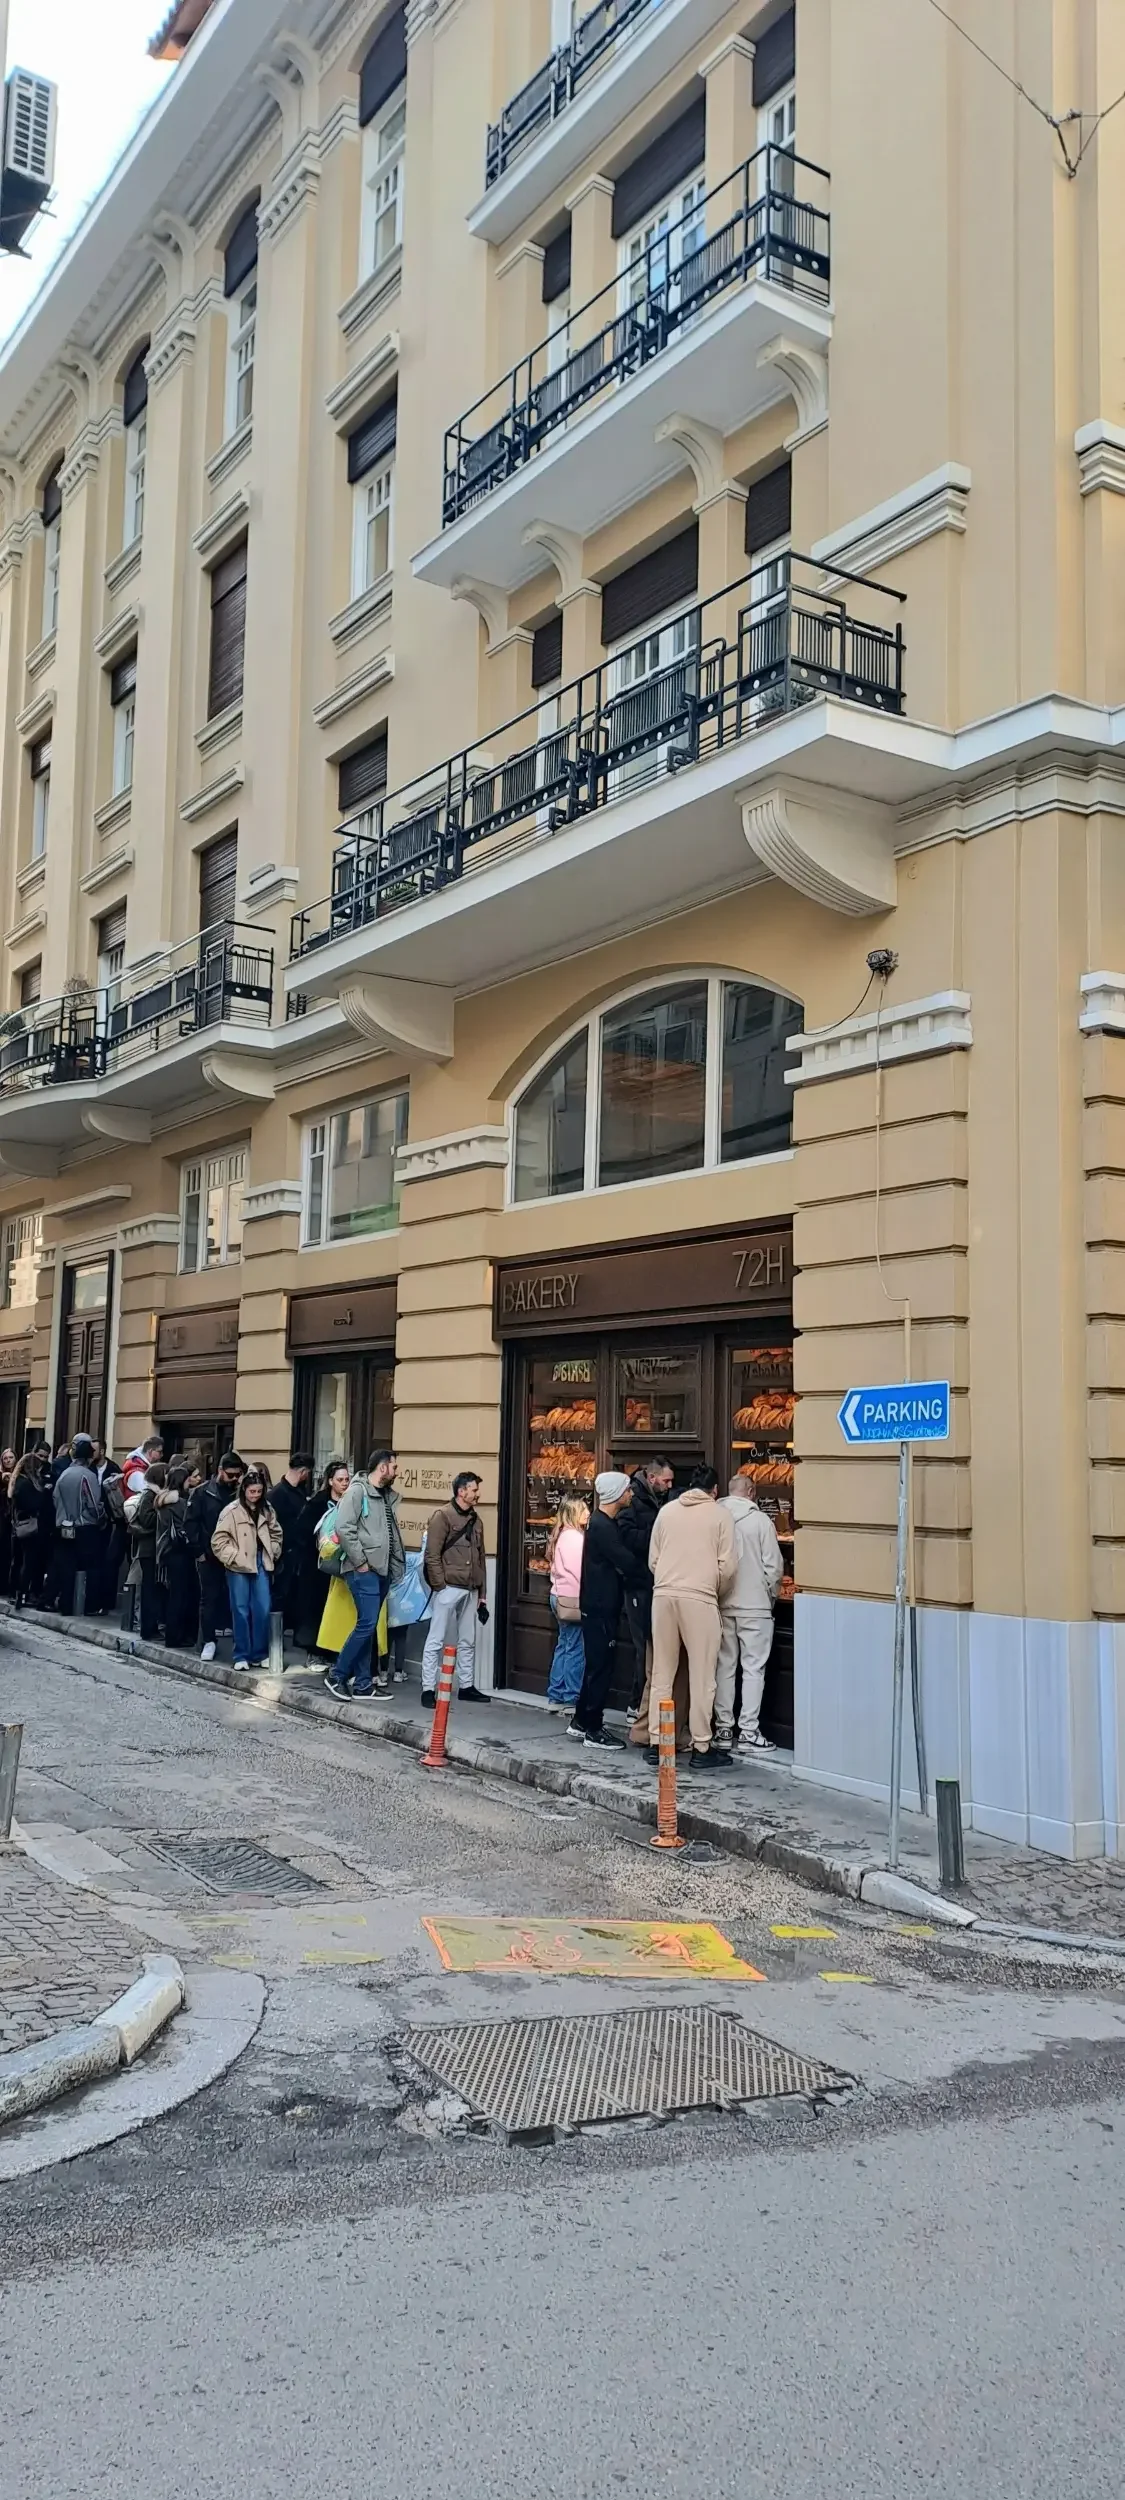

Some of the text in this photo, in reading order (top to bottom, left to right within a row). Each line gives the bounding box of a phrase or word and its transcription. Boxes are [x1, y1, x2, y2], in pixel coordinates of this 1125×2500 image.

[731, 1244, 787, 1288] 72H
[502, 1271, 582, 1314] BAKERY
[863, 1398, 943, 1424] PARKING
